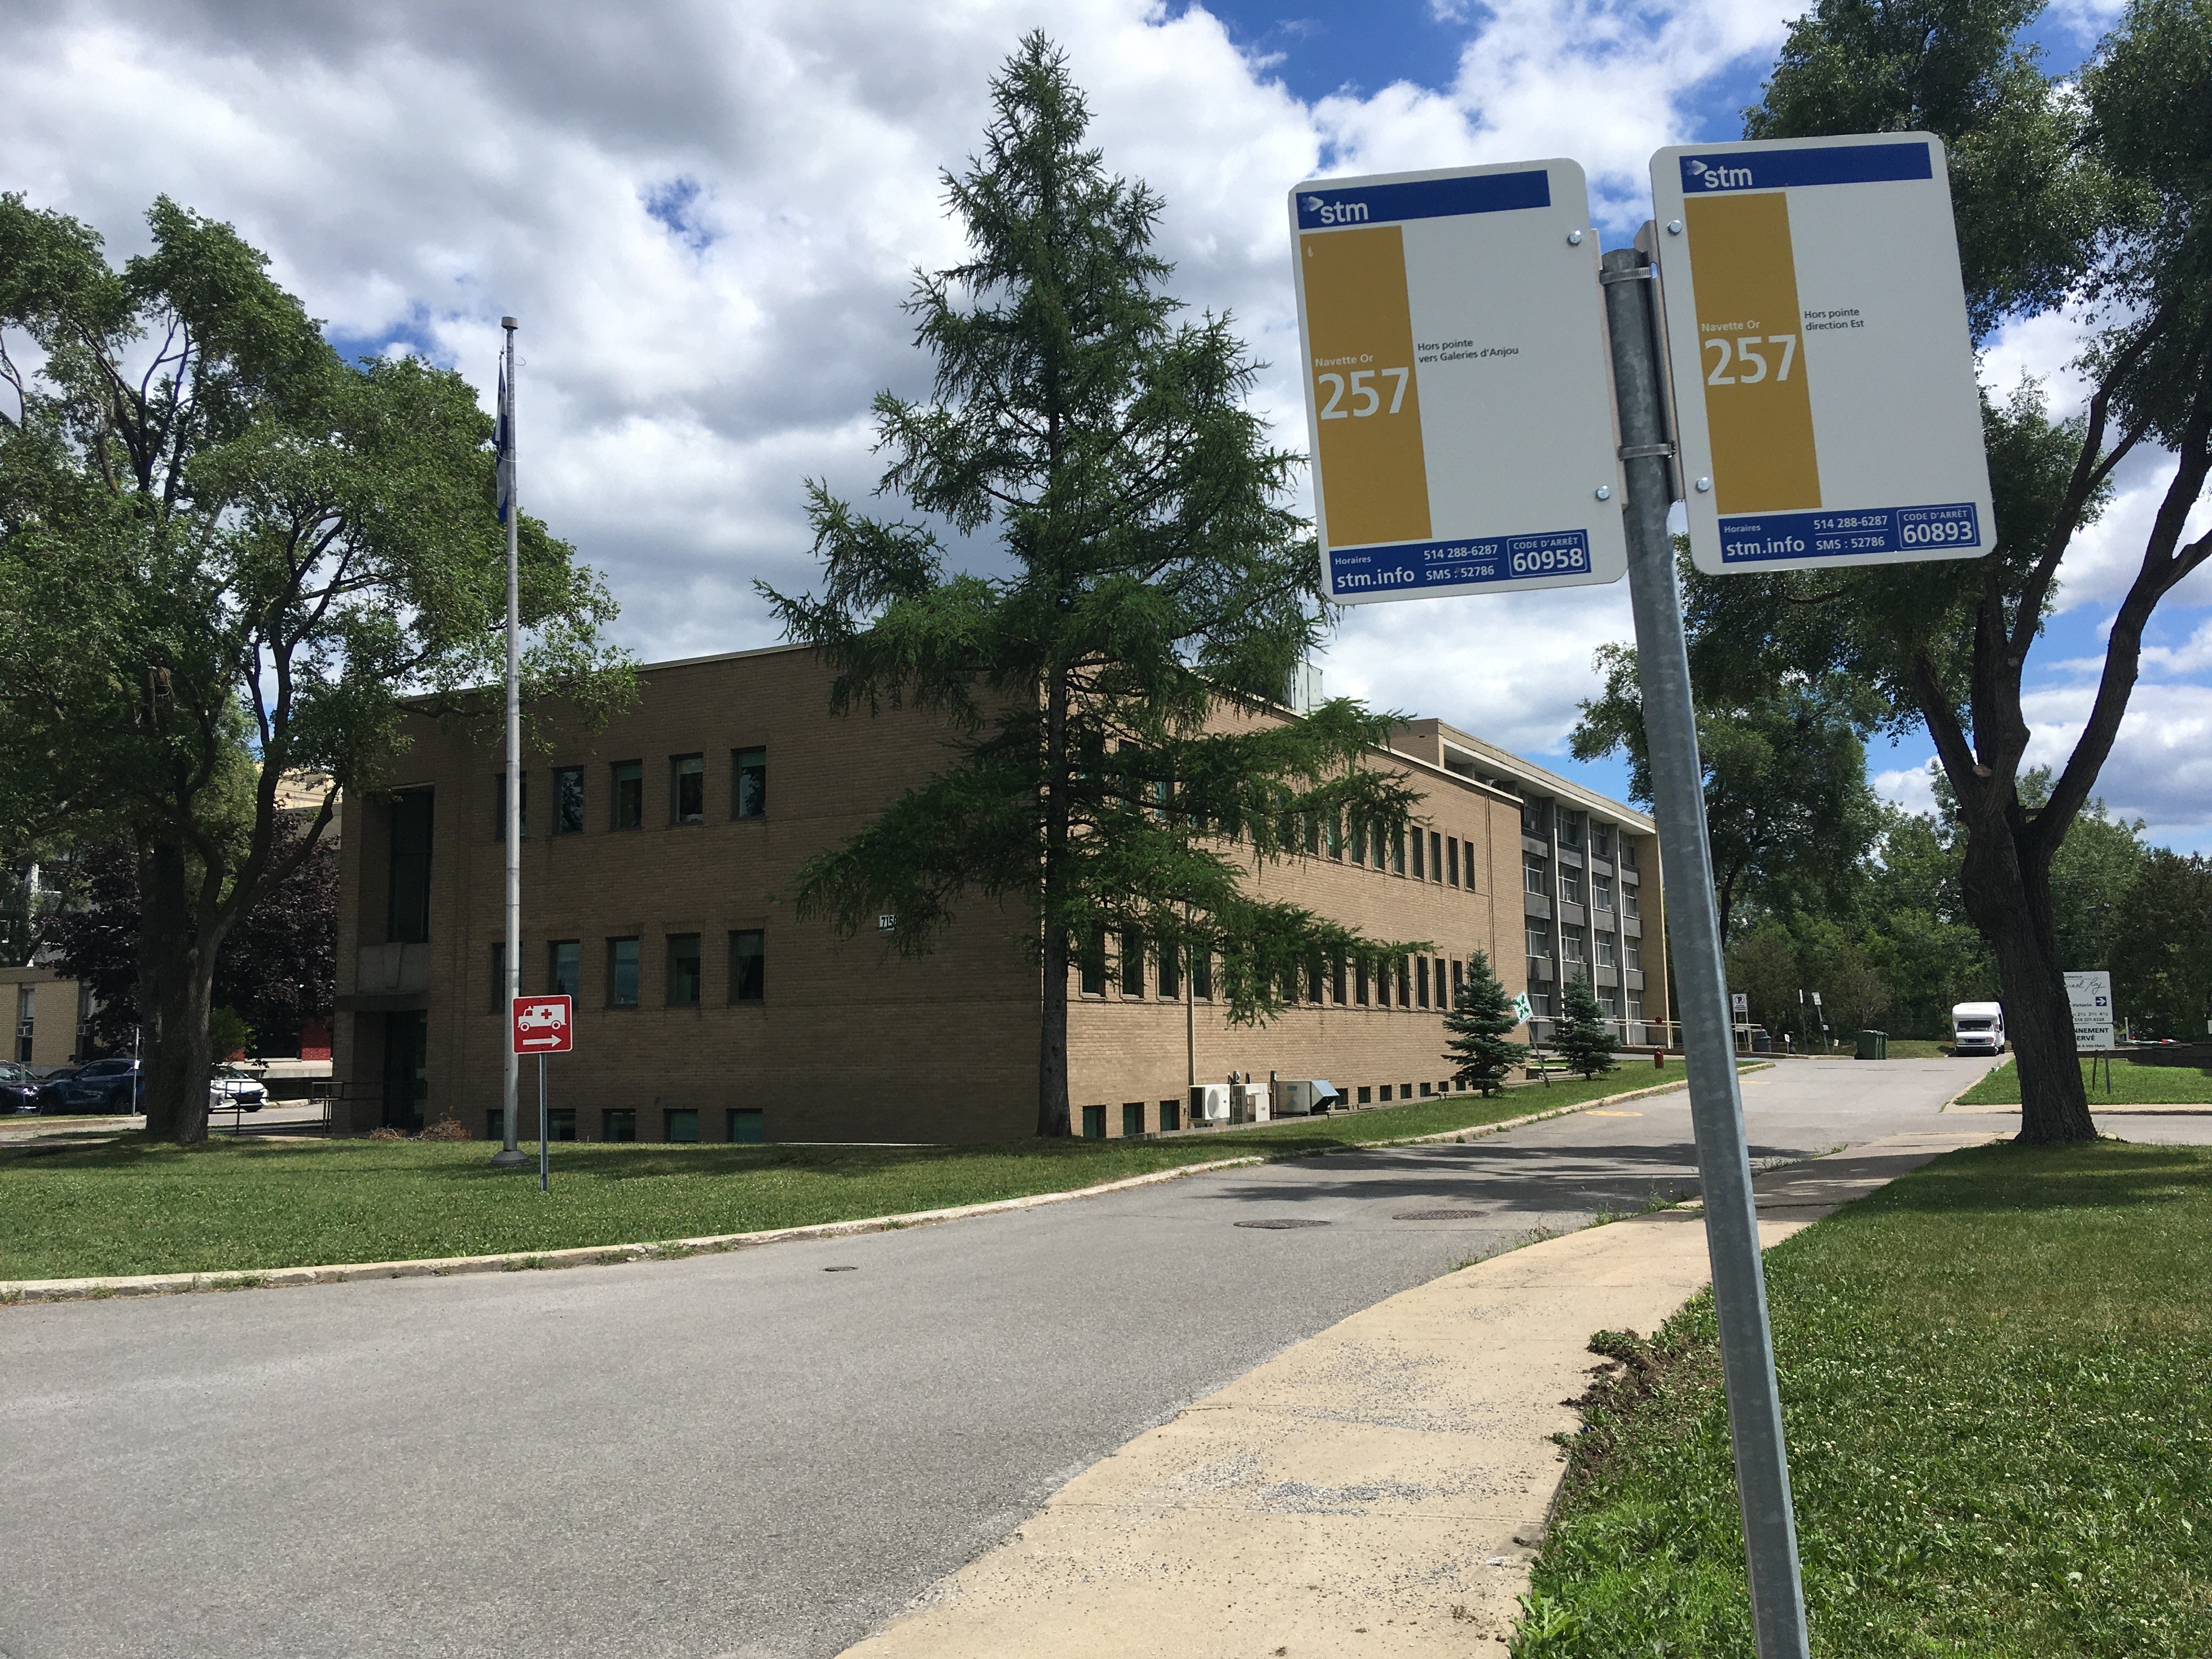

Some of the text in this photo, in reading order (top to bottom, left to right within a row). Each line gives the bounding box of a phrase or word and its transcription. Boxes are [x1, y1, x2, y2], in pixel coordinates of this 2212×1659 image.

[1705, 165, 1753, 188] stm
[1320, 200, 1369, 224] stm
[1804, 308, 1860, 319] Hors pointe
[1701, 320, 1760, 331] Navette Or
[1805, 319, 1865, 330] direction Est
[1418, 339, 1474, 351] Hors pointe
[1315, 354, 1373, 367] Navette Or
[1418, 347, 1519, 363] vers Galeries d'Anjou
[1705, 334, 1796, 386] 257
[1318, 366, 1409, 420] 257
[1814, 515, 1888, 530] 514 288-6287
[1903, 509, 1967, 521] CODE D'ARRÊT
[1724, 524, 1761, 533] Horaires
[1903, 521, 1973, 544] 60893
[1513, 537, 1578, 550] CODE D'ARRÊT
[1726, 535, 1805, 556] stm.info
[1816, 539, 1841, 550] SMS
[1851, 536, 1885, 548] 52786
[1424, 544, 1498, 560] 514 288-6287
[1335, 556, 1372, 565] Horaires
[1513, 548, 1584, 572] 60958
[1337, 567, 1415, 588] stm.info
[1426, 568, 1451, 580] SMS
[1461, 565, 1494, 577] 52786
